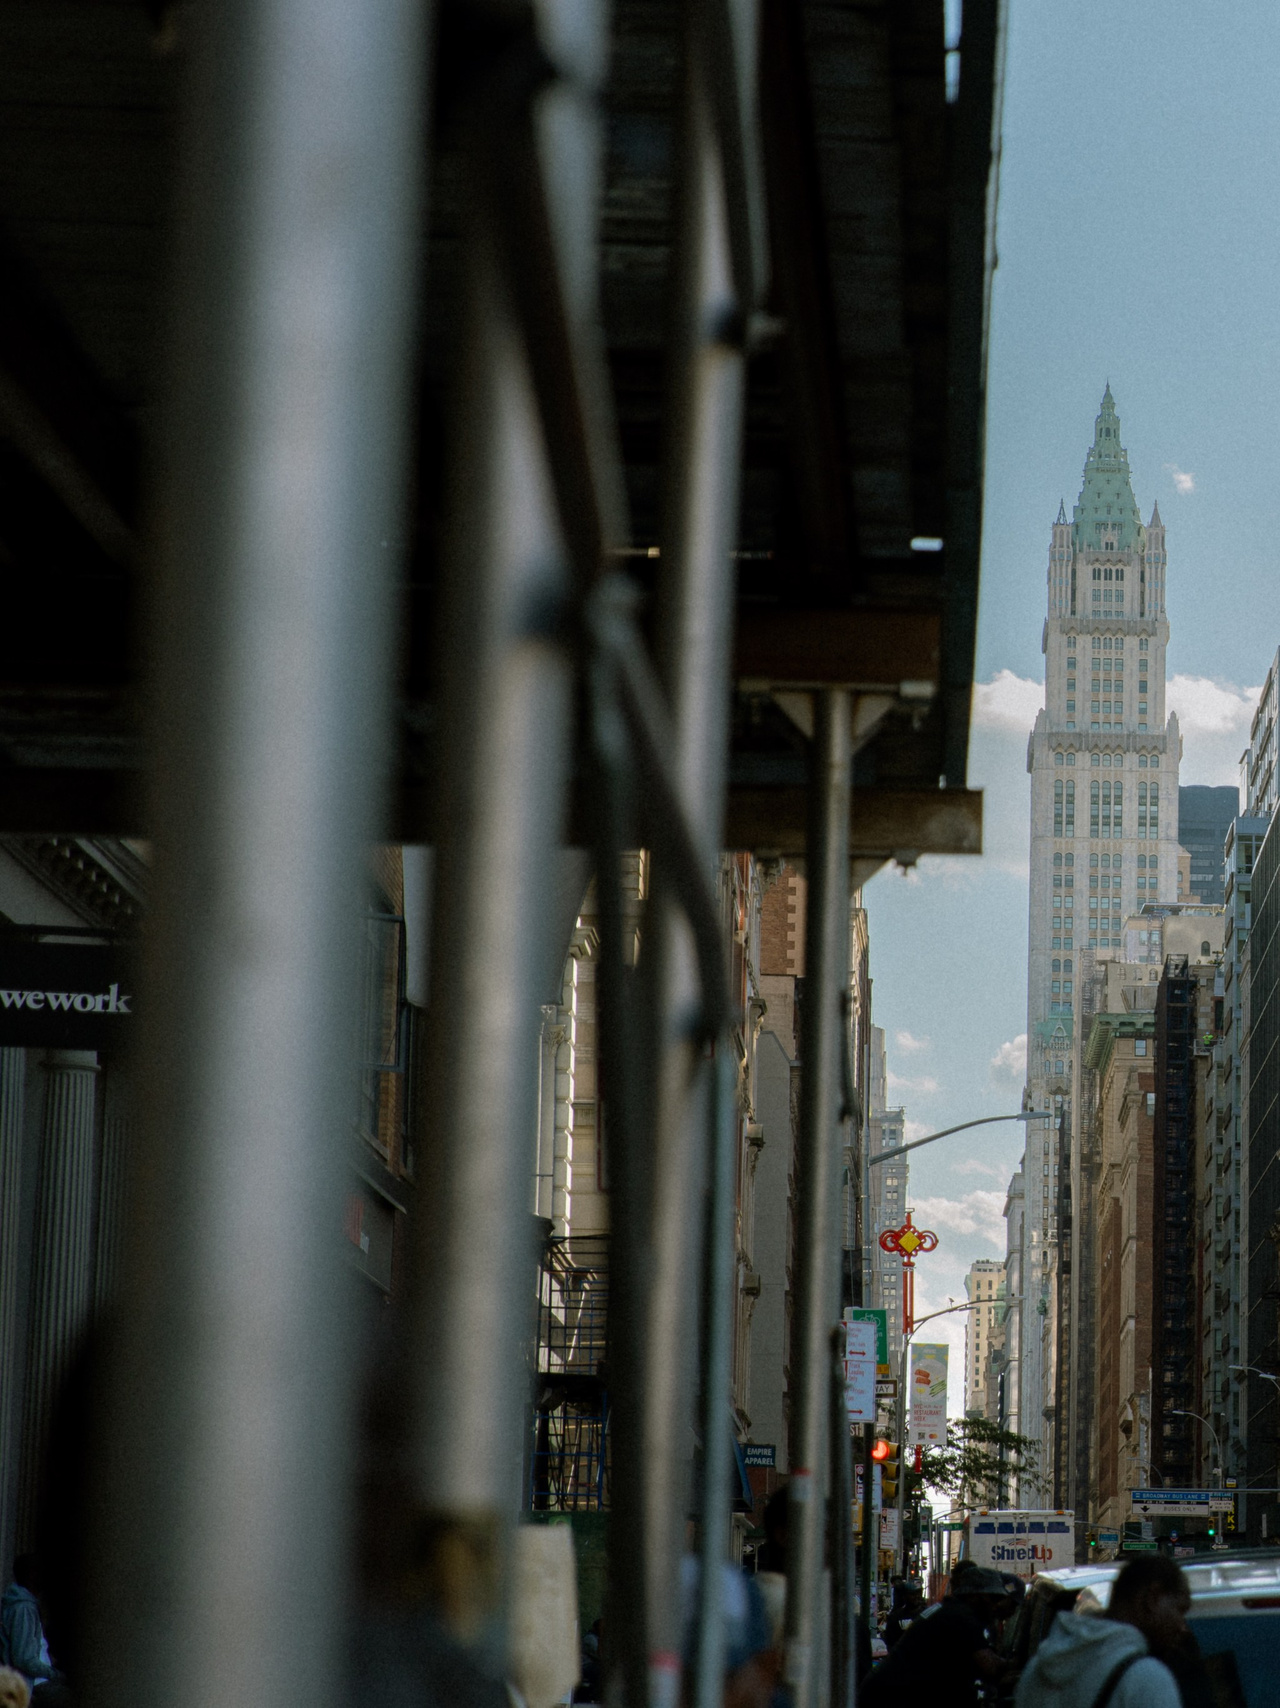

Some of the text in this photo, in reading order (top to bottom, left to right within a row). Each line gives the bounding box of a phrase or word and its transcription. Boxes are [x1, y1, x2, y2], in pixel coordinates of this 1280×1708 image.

[0, 983, 132, 1013] wework
[747, 1448, 773, 1456] EMPIRE
[744, 1457, 774, 1466] APPAREL
[991, 1545, 1053, 1563] ShredUp
